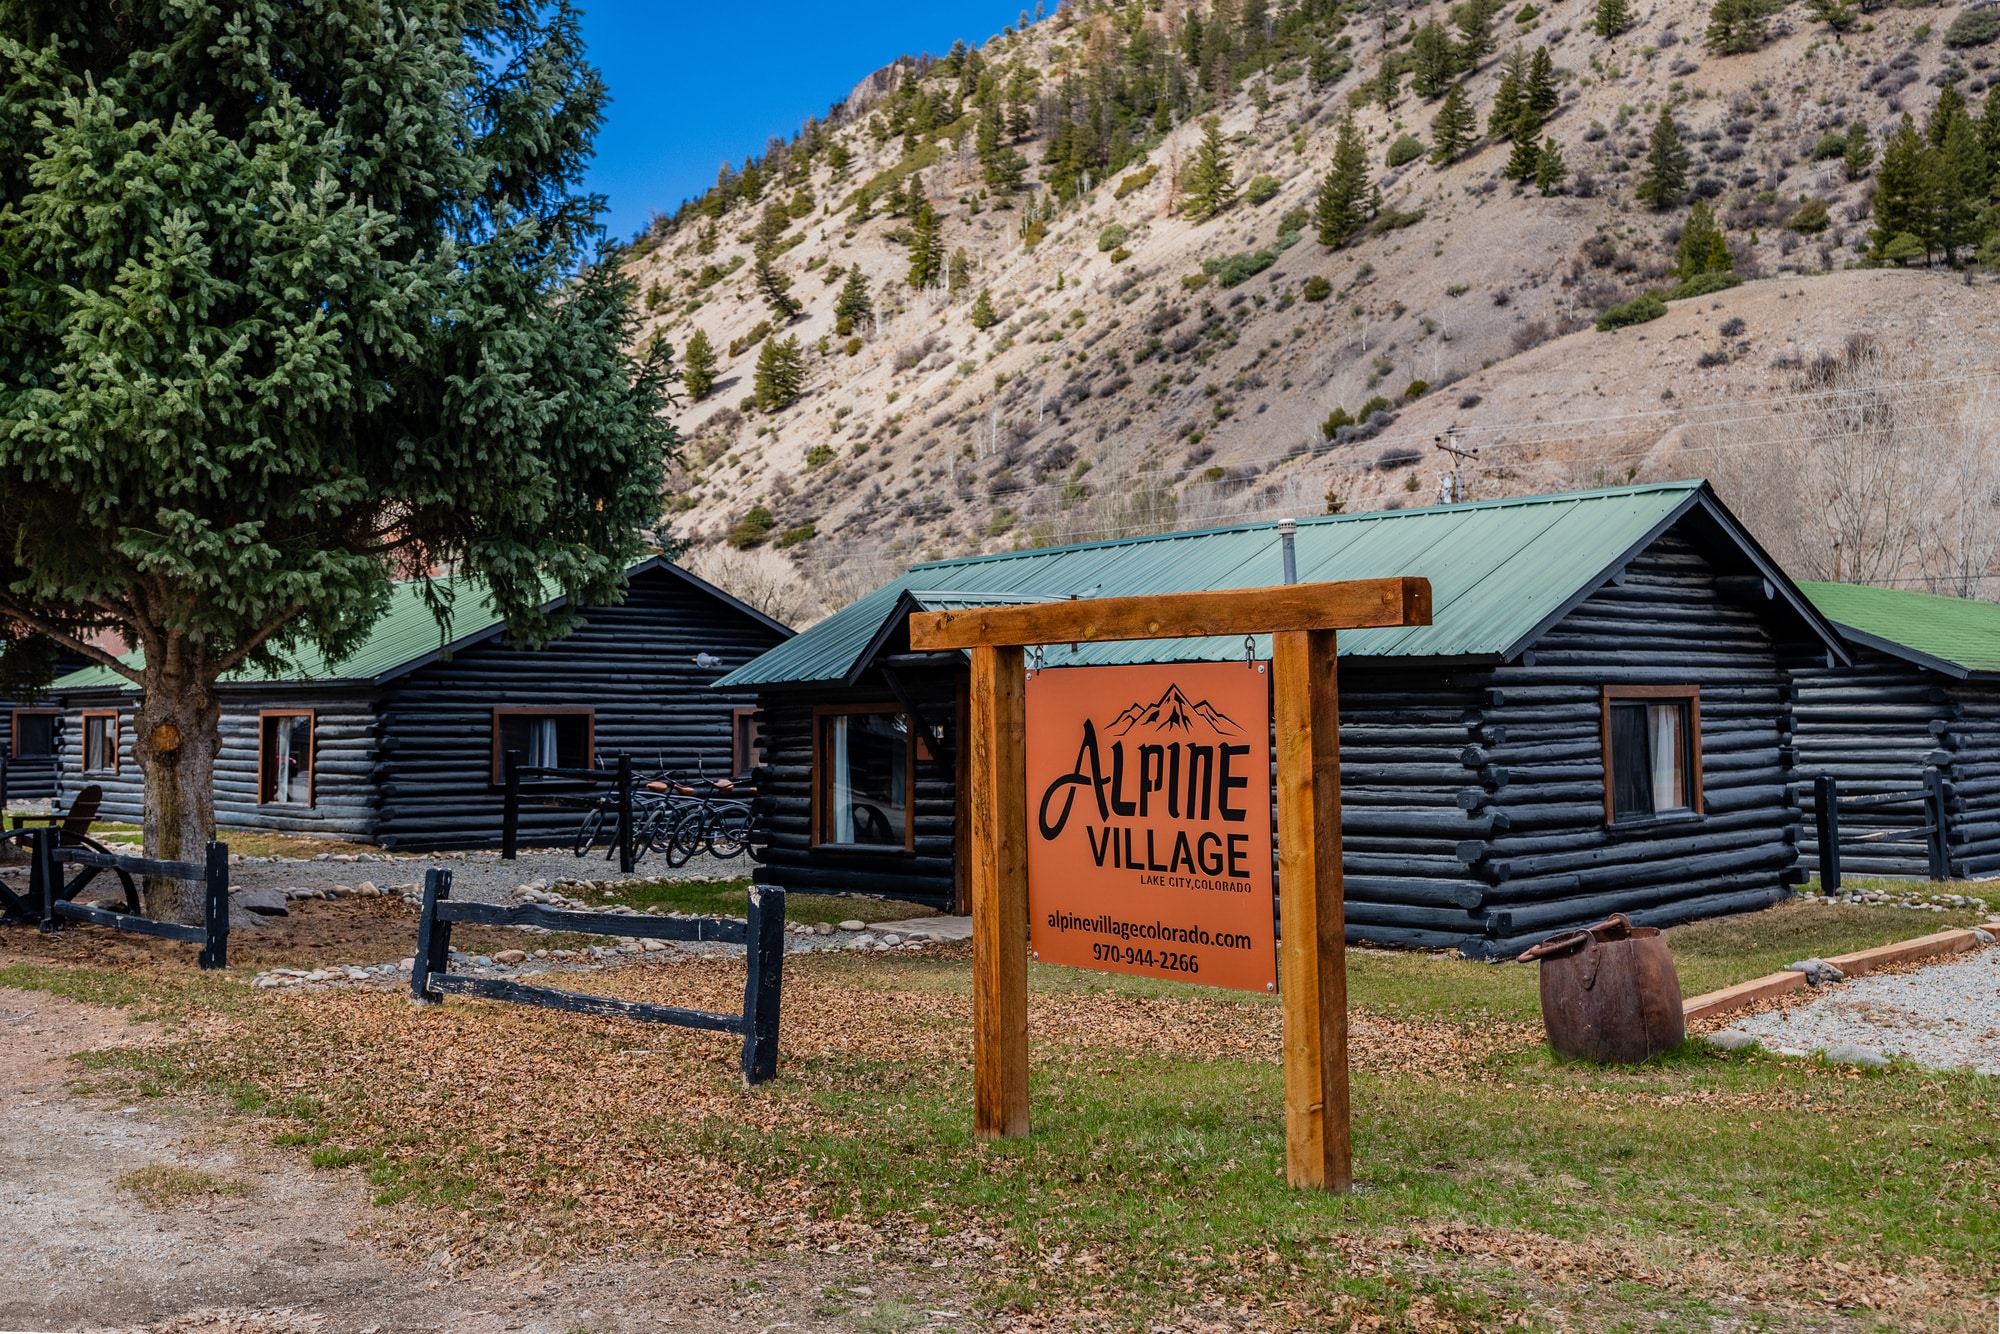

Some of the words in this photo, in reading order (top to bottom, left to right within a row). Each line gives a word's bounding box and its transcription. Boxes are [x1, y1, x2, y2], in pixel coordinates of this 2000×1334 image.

[1039, 719, 1250, 841] ALPINE
[1086, 825, 1250, 878] VILLAGE
[1140, 874, 1166, 887] LAKE
[1047, 910, 1251, 950] alpinevillagecolorado.com
[1093, 943, 1199, 973] 970-944-2266
